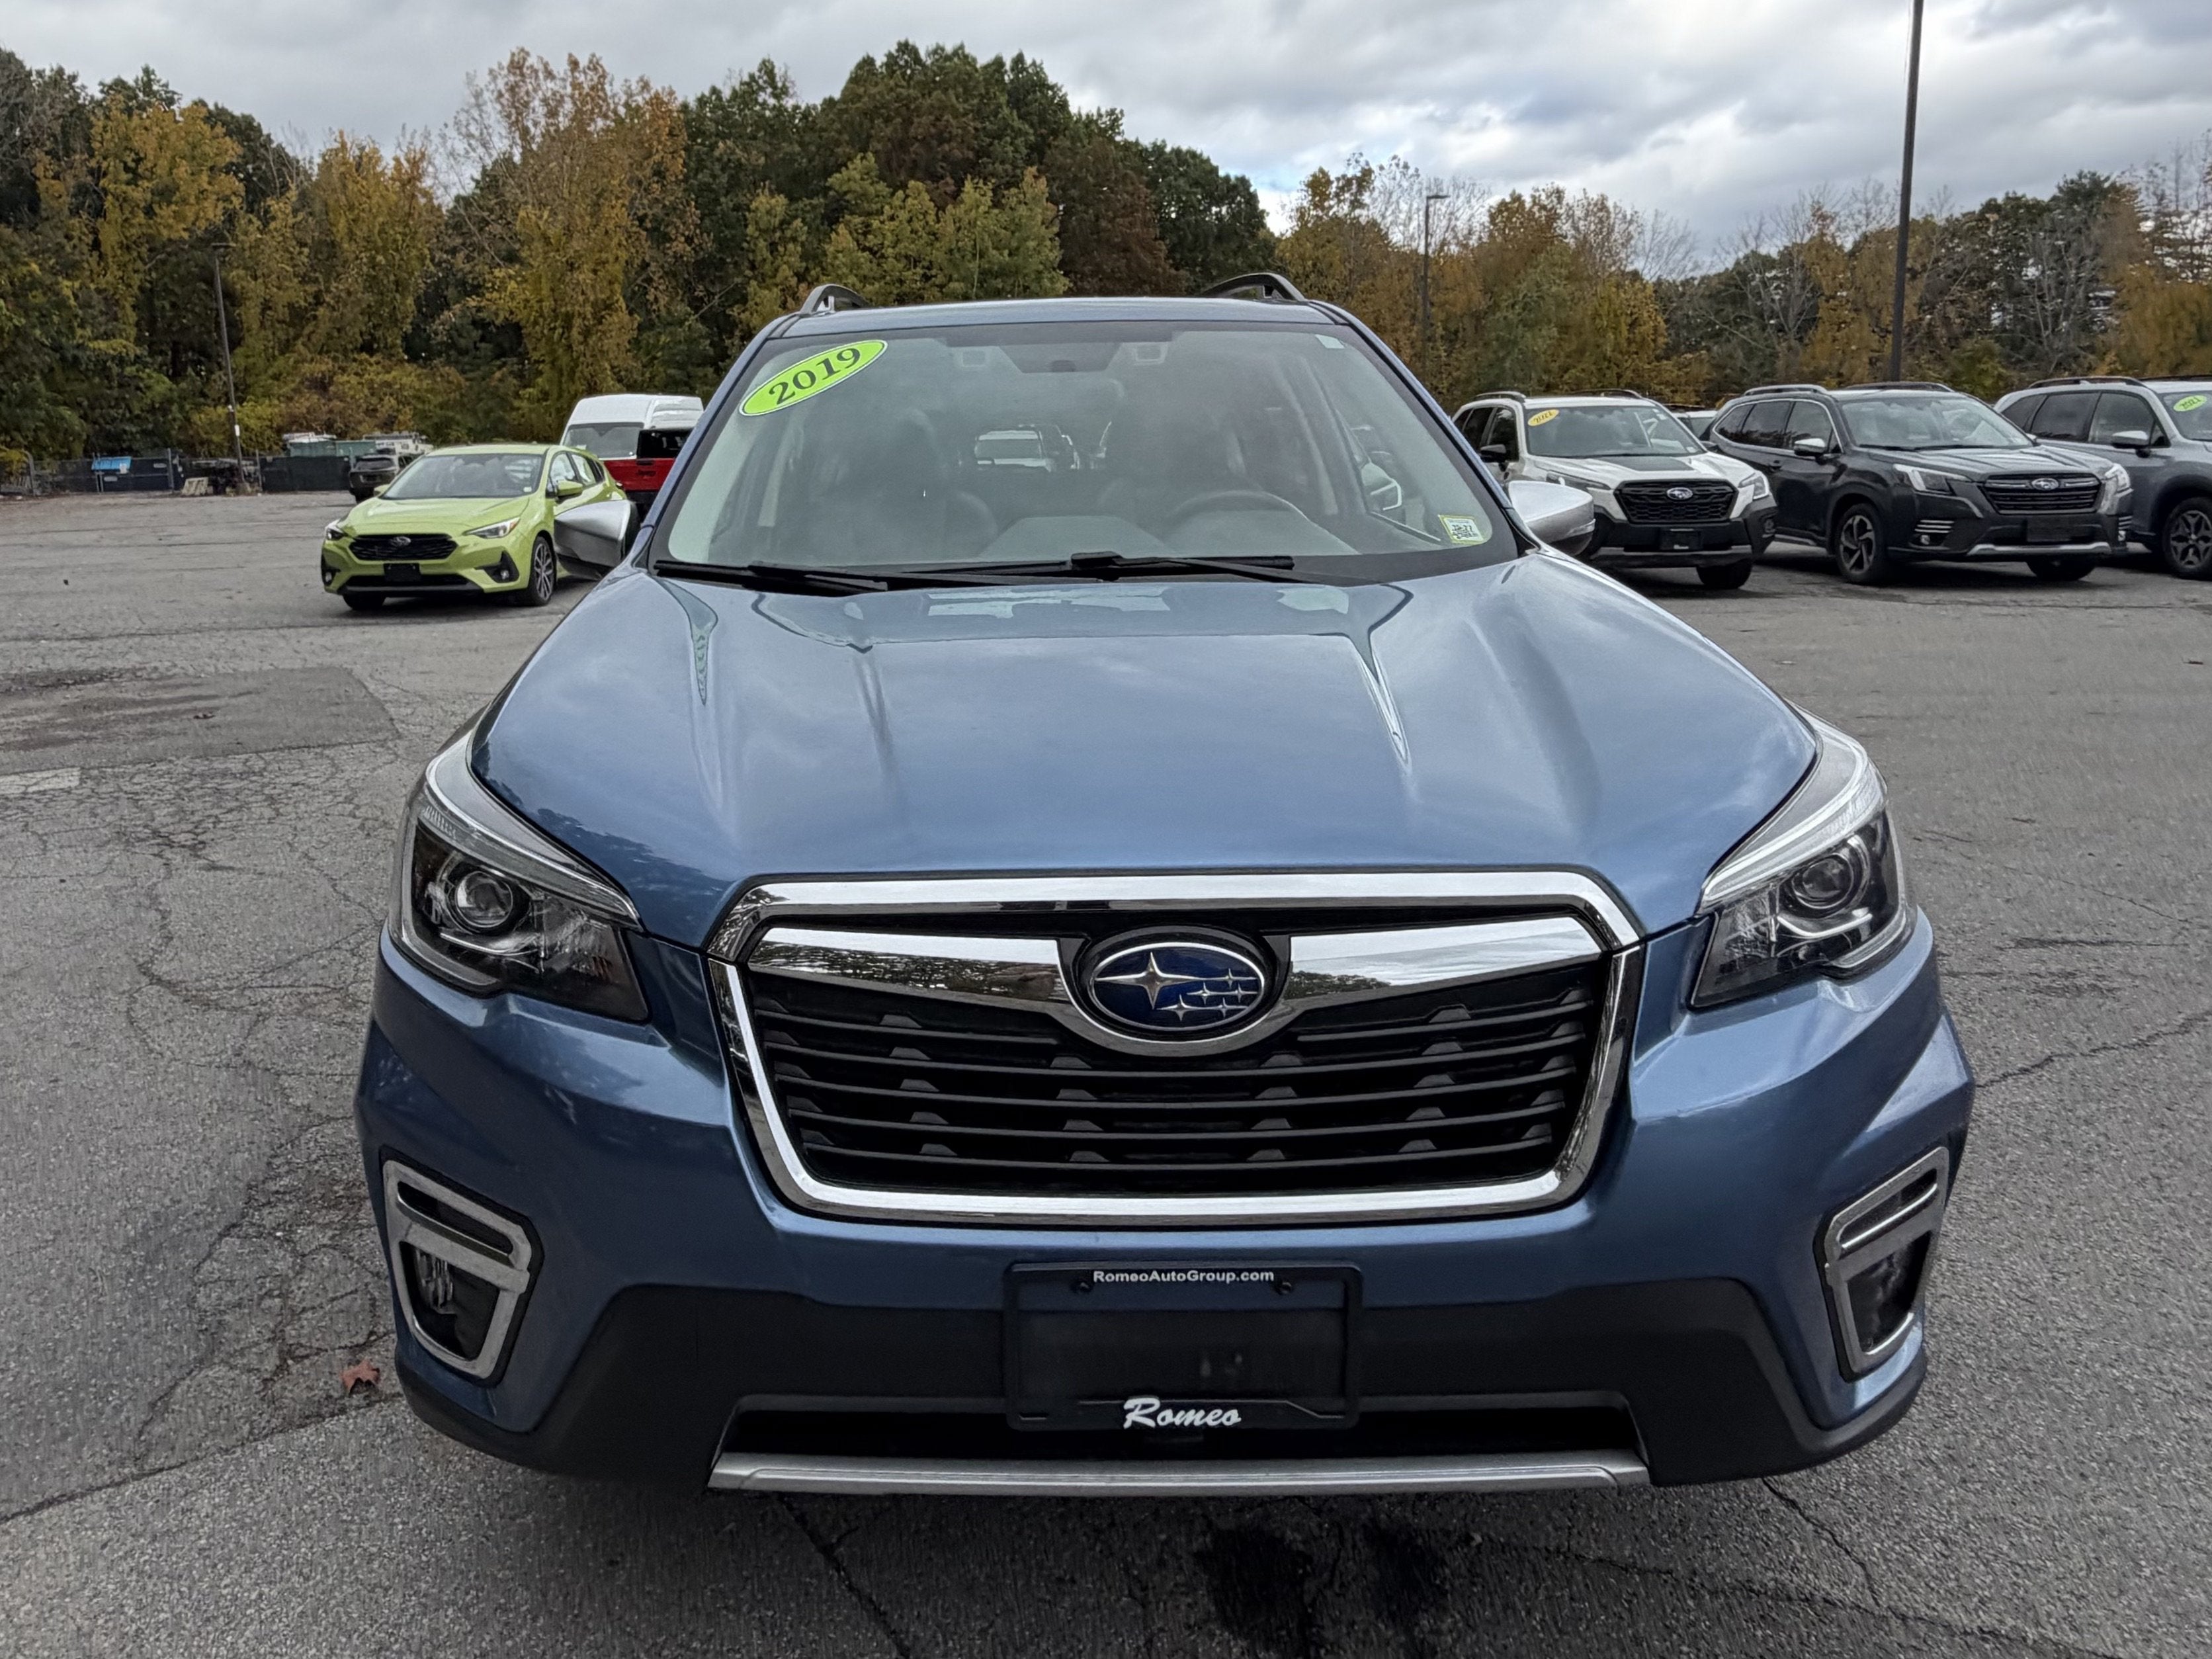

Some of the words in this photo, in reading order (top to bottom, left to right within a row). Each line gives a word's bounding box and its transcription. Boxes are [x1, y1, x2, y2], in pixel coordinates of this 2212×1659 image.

[769, 348, 861, 405] 2019
[1093, 1270, 1275, 1284] RomeoAutoGroup.com
[1123, 1396, 1242, 1429] Romeo
